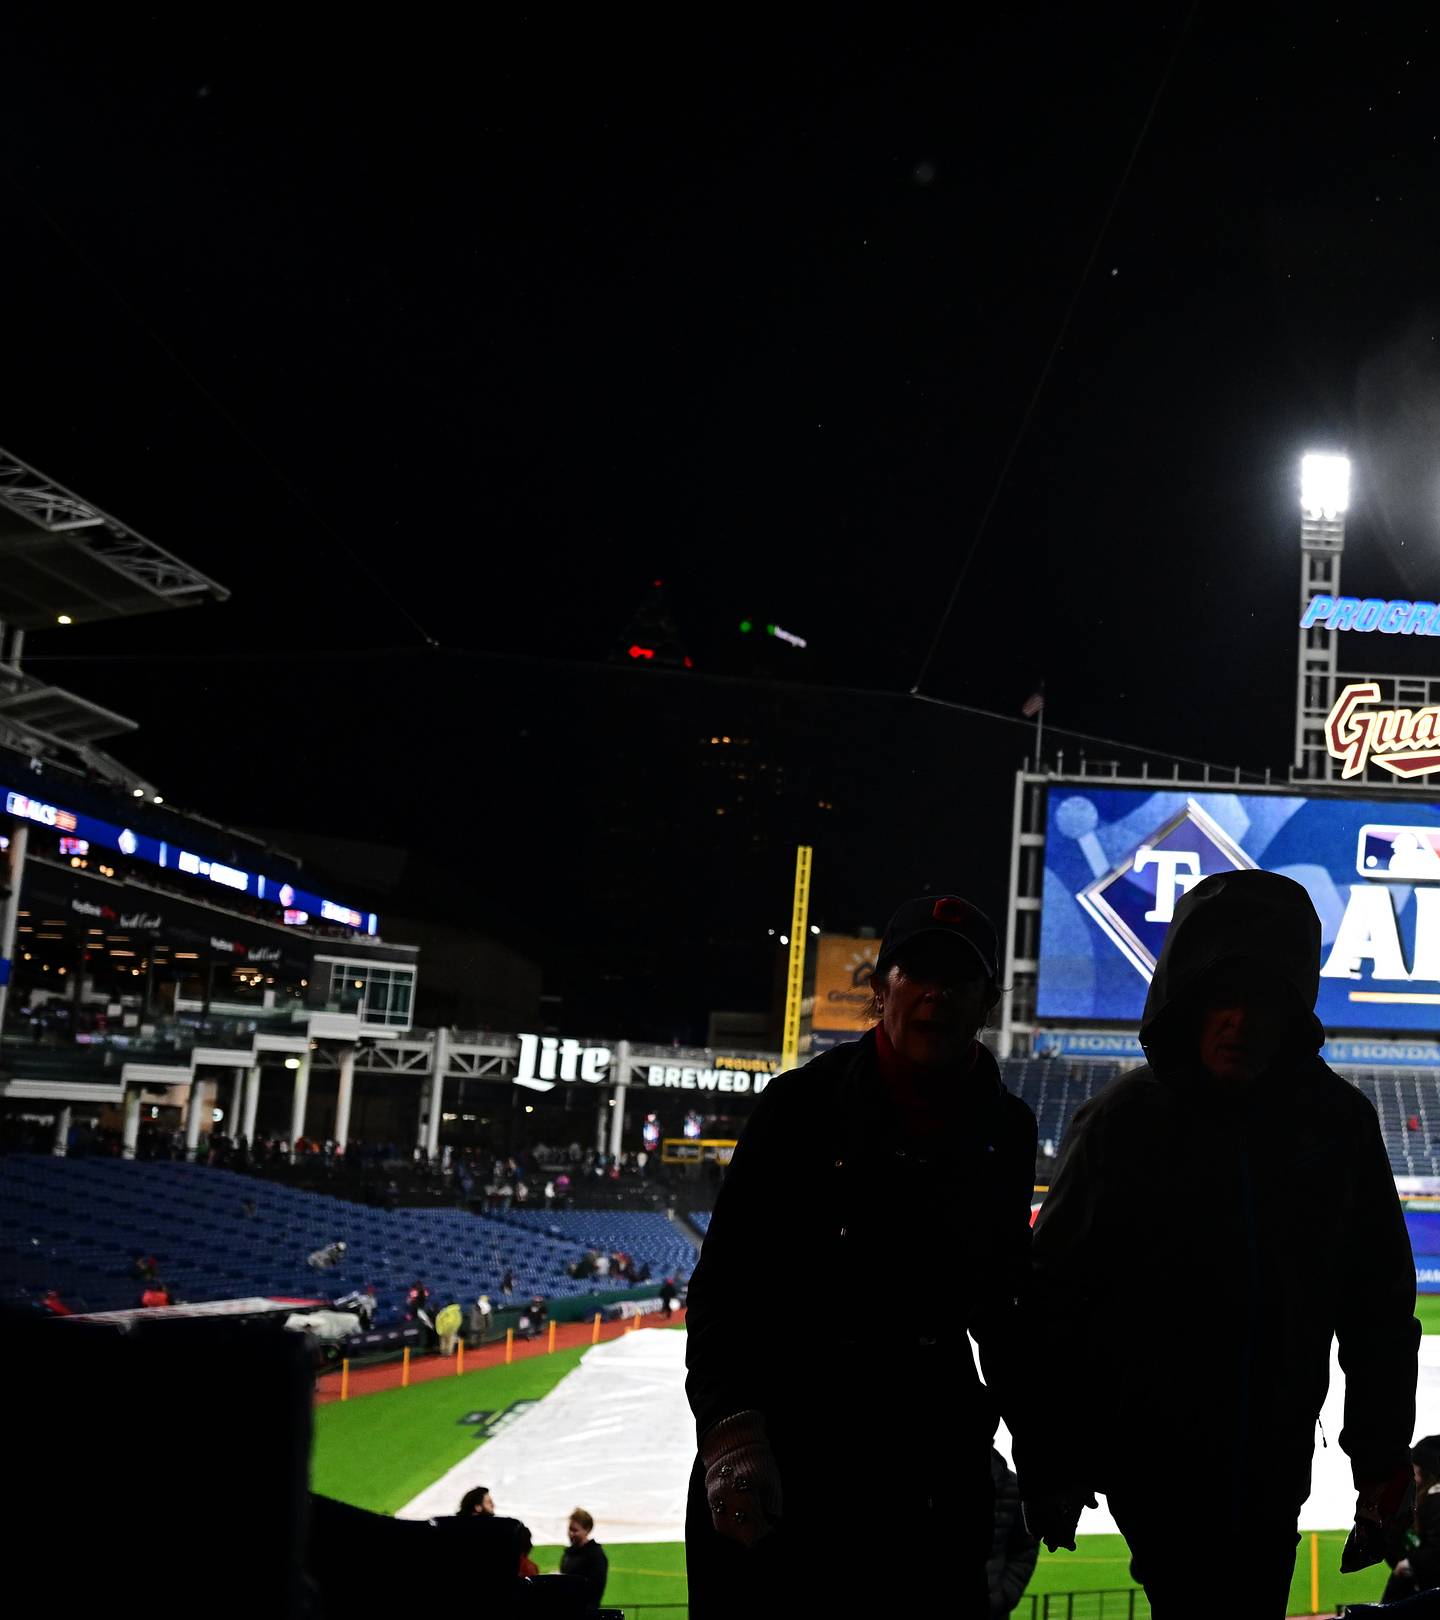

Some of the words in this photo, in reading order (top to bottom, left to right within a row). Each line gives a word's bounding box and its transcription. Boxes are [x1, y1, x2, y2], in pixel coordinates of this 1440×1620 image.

[1067, 1034, 1141, 1051] HOND
[513, 1033, 611, 1092] Lite
[648, 1064, 751, 1093] BREWED
